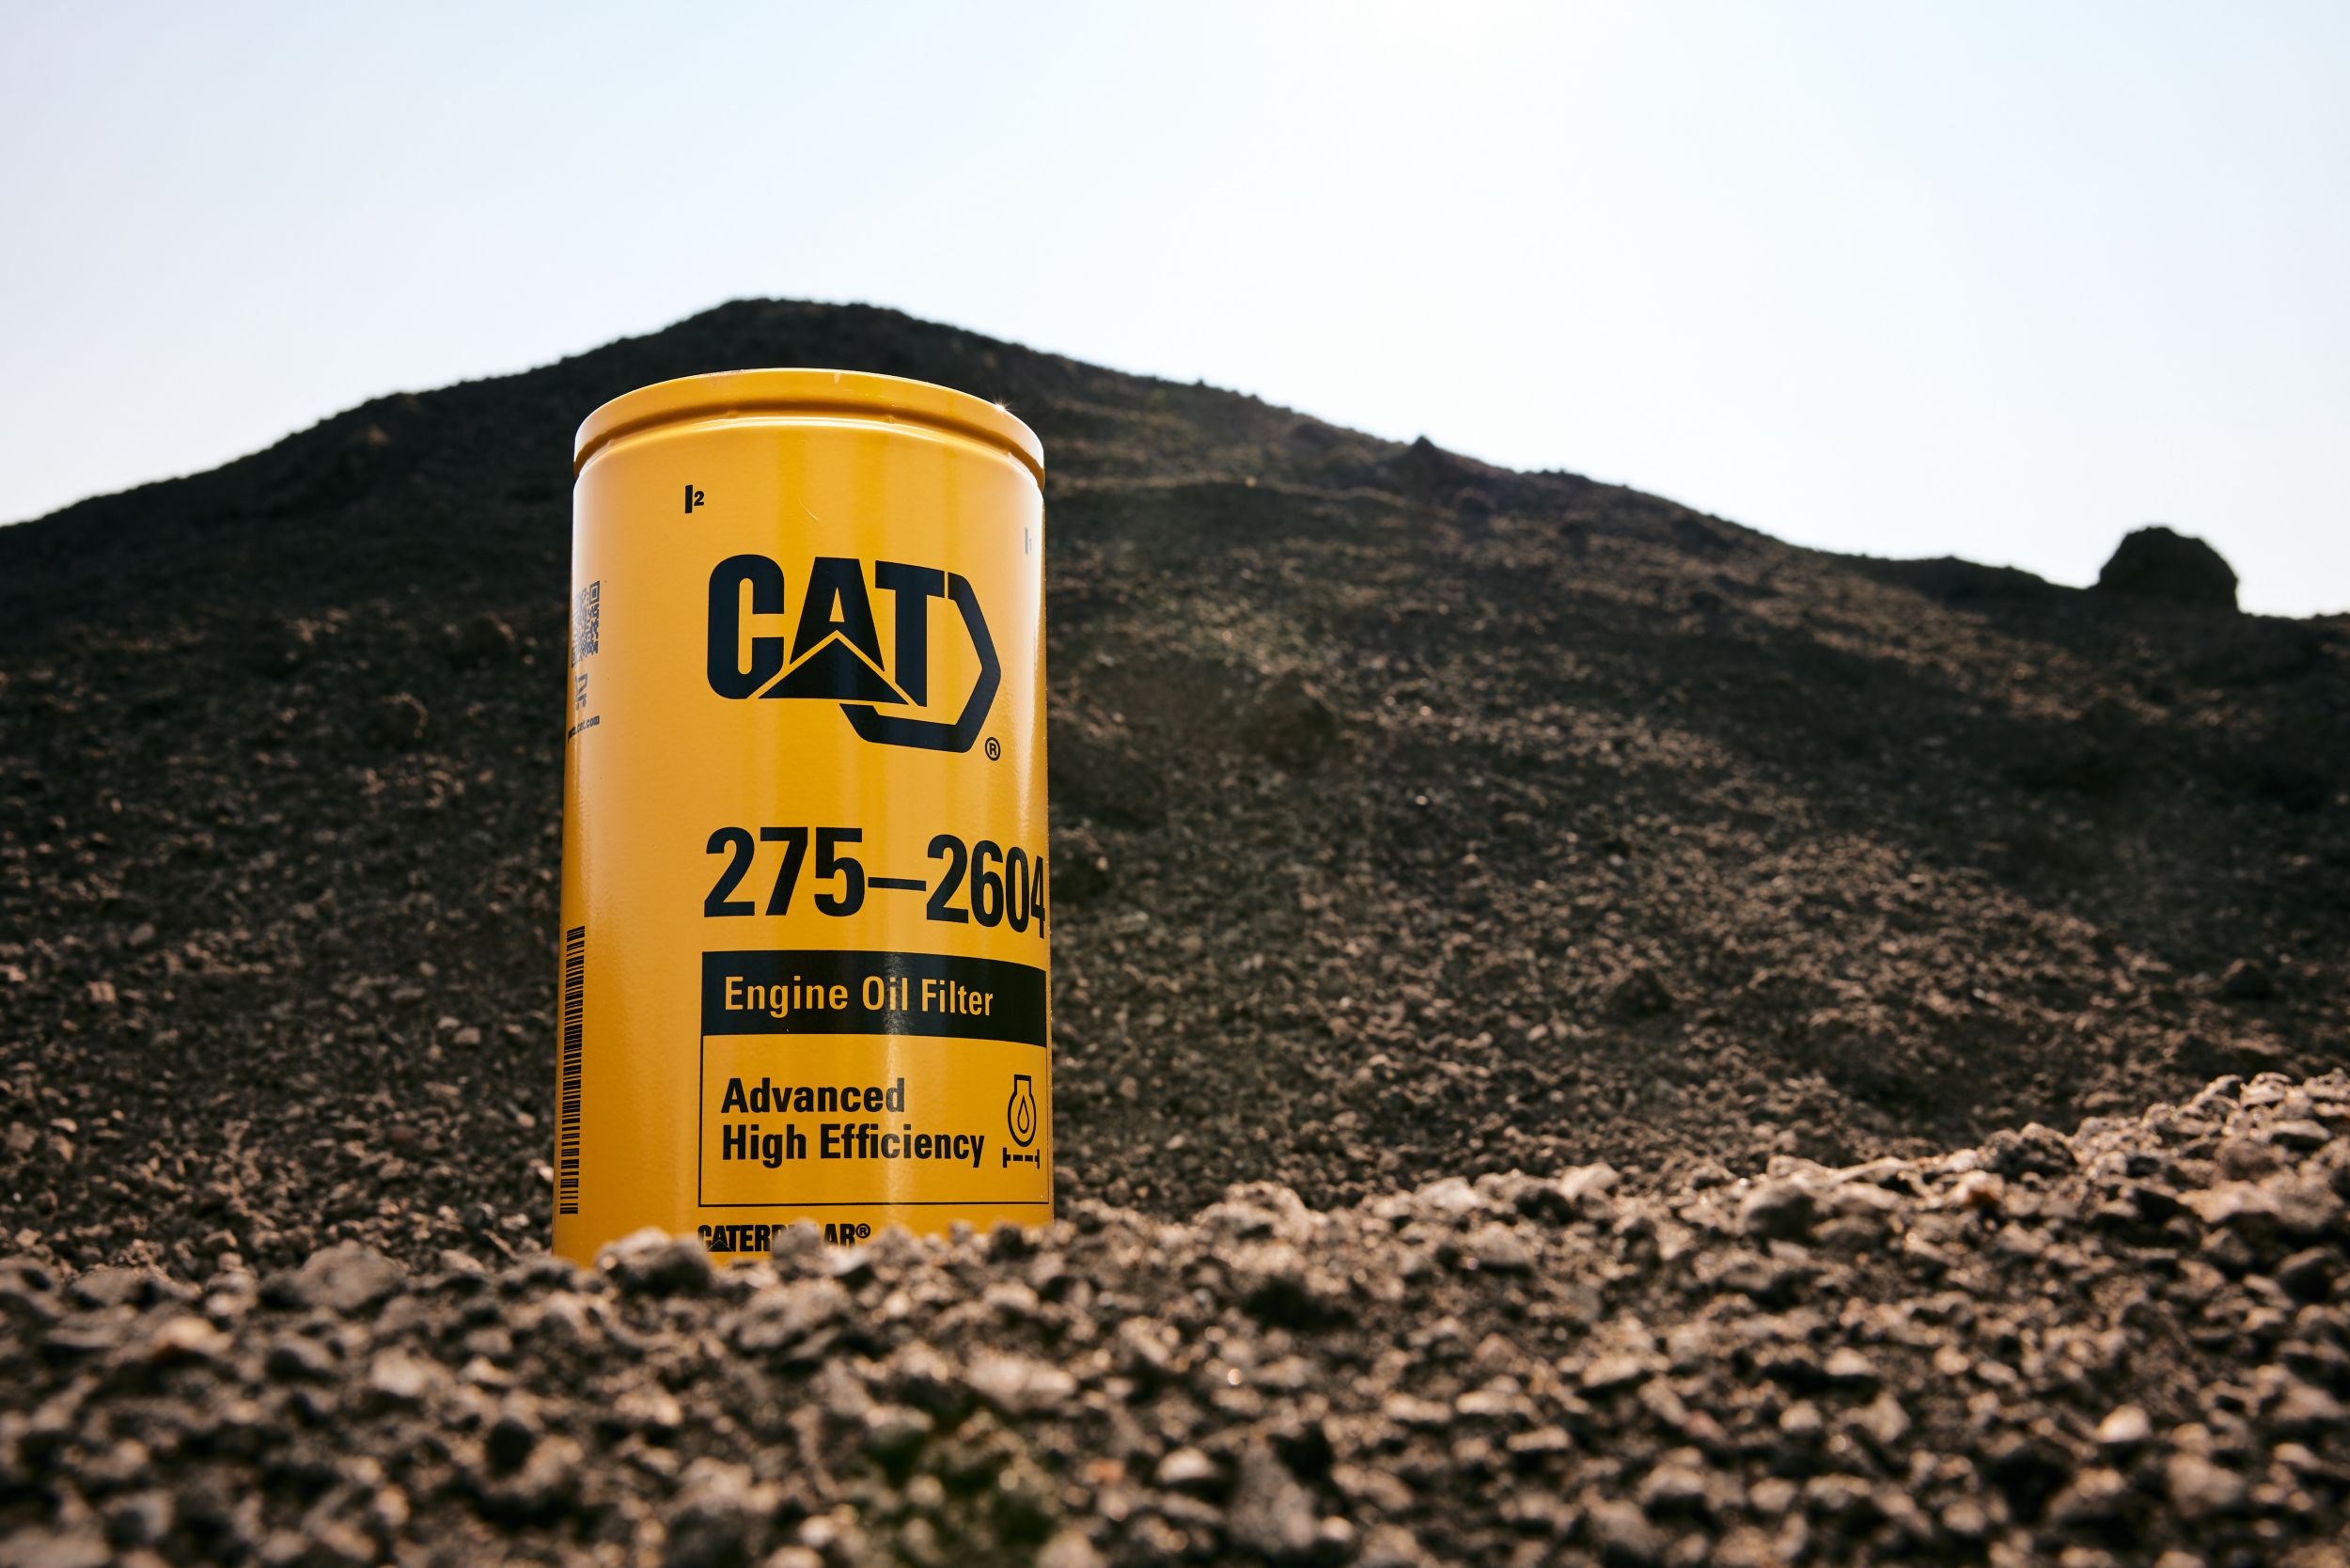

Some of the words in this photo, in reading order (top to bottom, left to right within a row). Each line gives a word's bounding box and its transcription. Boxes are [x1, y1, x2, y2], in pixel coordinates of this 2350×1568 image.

[707, 554, 946, 708] CAT
[725, 975, 848, 1018] Engine
[862, 976, 908, 1012] Oil
[921, 979, 994, 1016] Filter
[721, 1077, 905, 1114] Advanced
[722, 1124, 807, 1168] High
[820, 1123, 985, 1168] Efficiency
